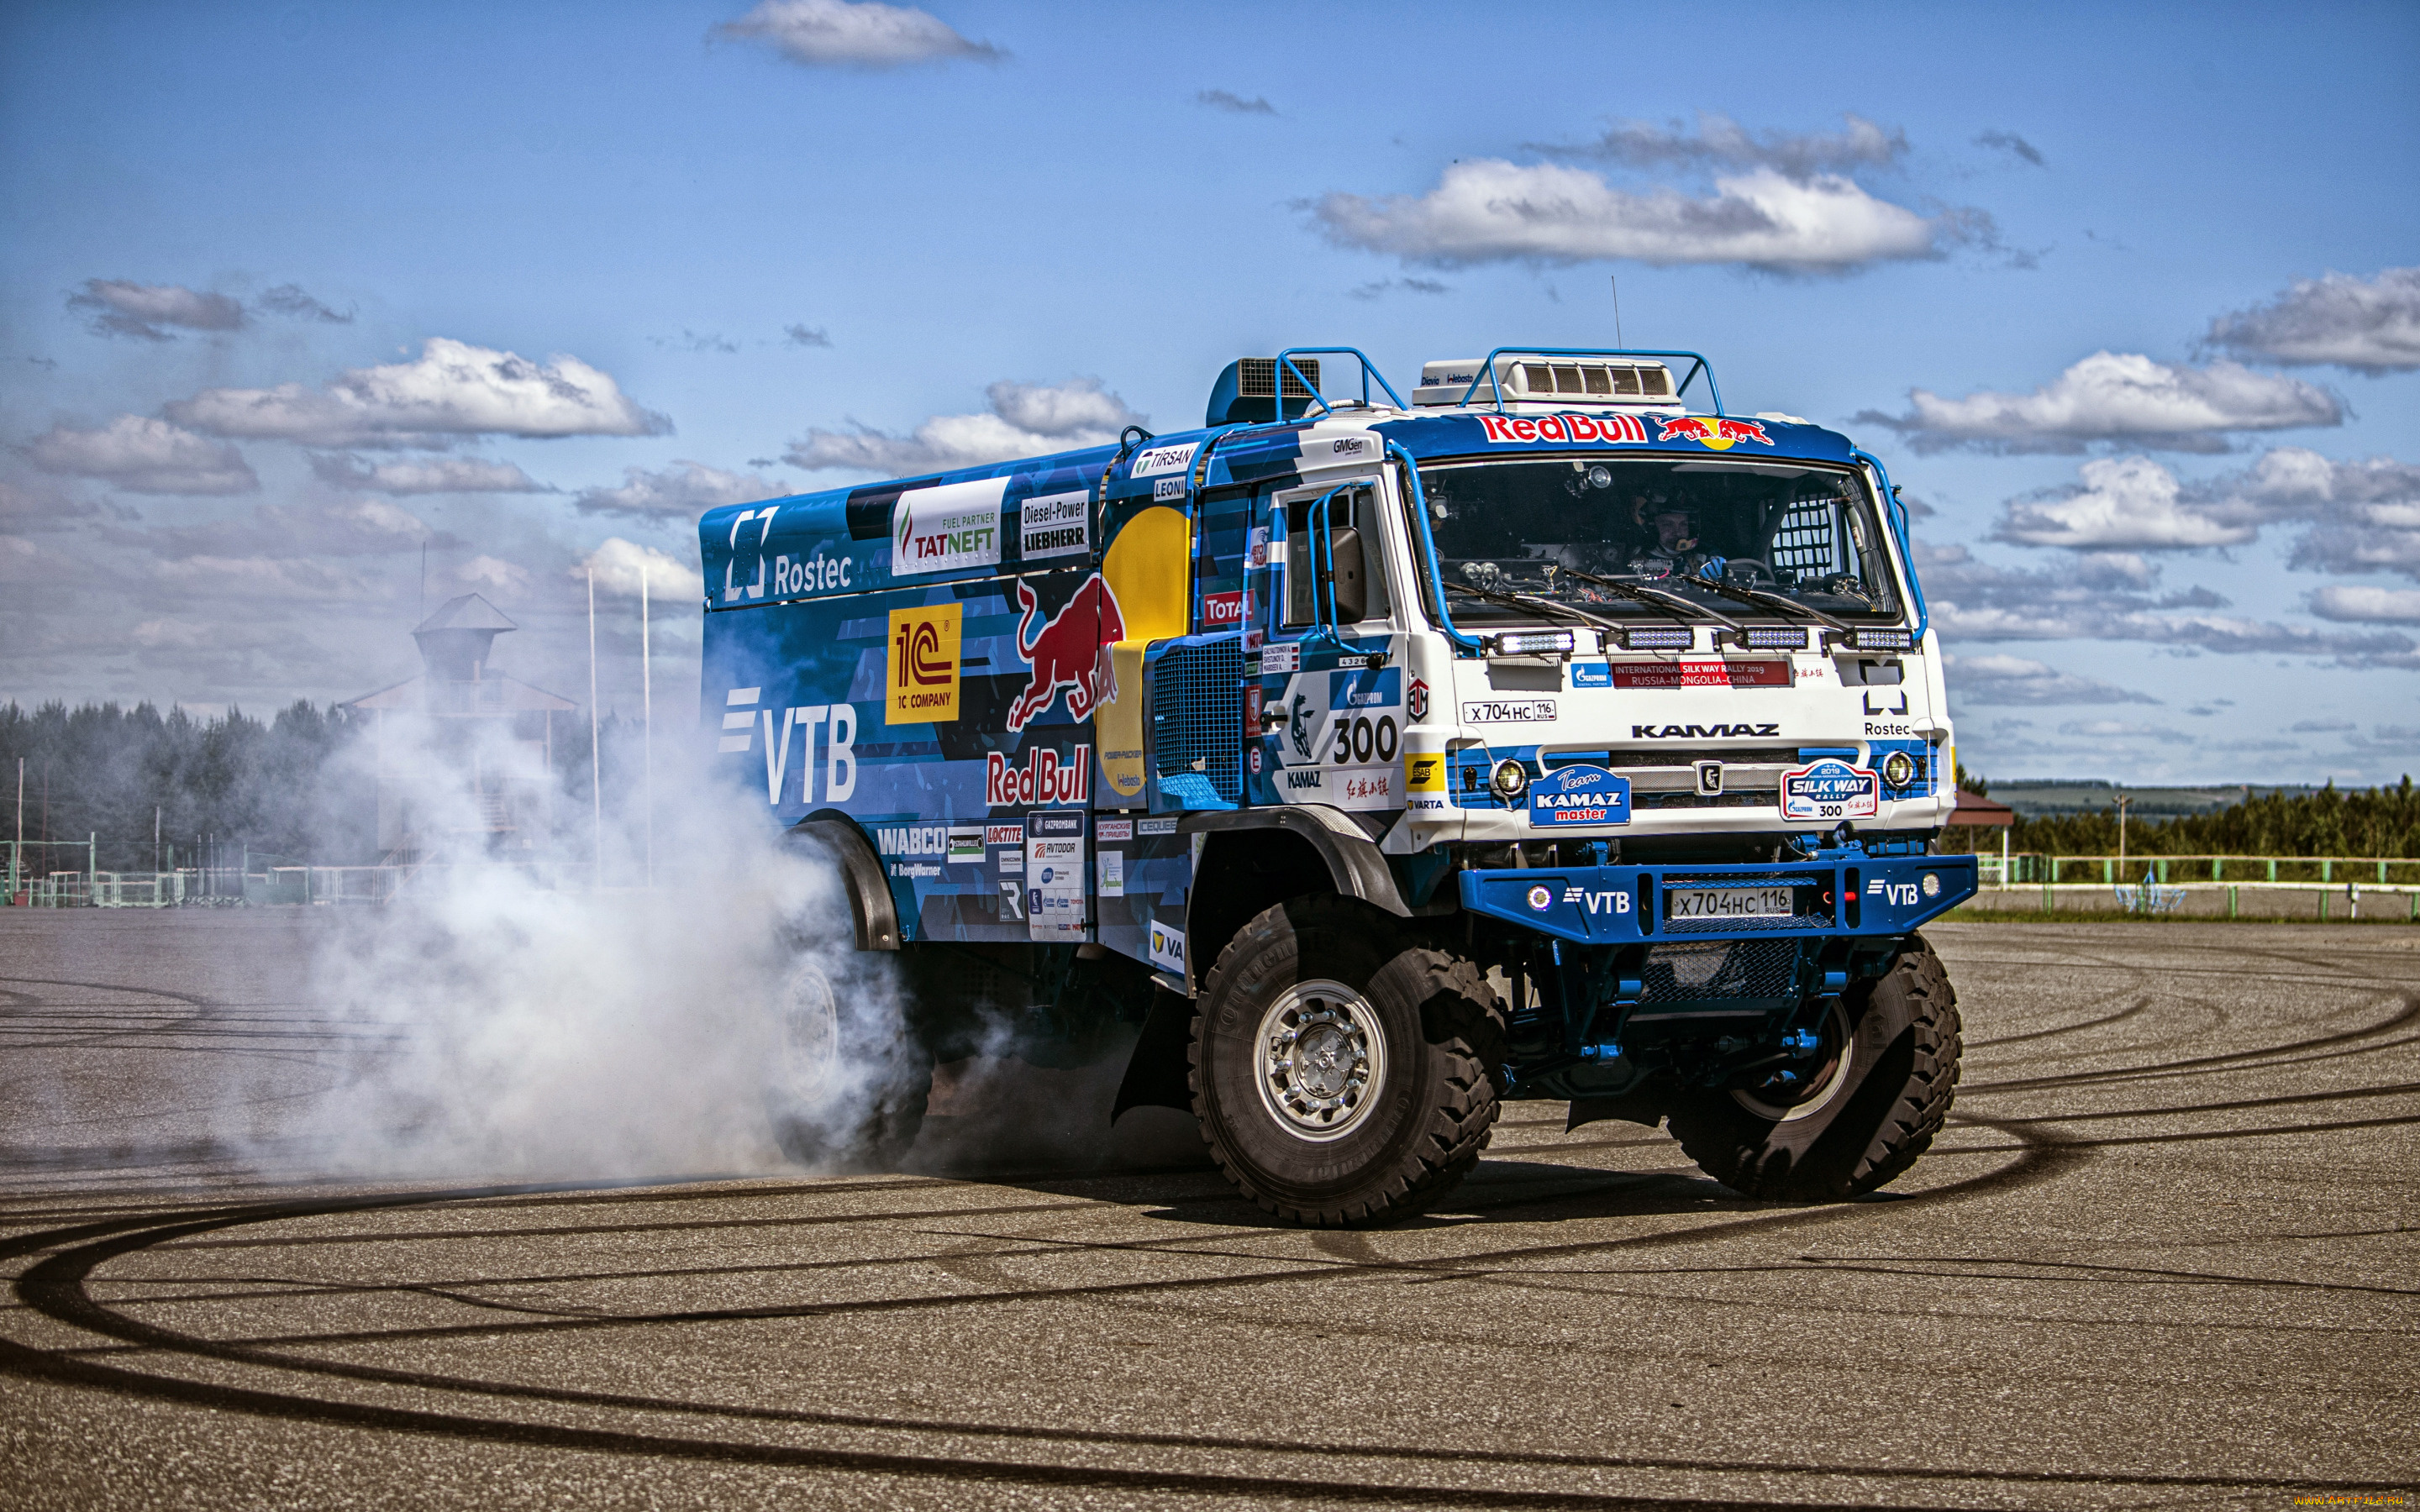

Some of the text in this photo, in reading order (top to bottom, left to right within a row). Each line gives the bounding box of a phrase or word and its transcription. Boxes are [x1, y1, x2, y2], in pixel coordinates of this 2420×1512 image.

[1422, 374, 1473, 386] Diavia Webasto
[1334, 438, 1362, 453] GMGen
[1155, 480, 1185, 497] LEONI
[1024, 501, 1085, 524] Diesel-Power
[943, 512, 995, 530] FUEL PARTNER
[915, 528, 994, 558] TATNEFT
[1024, 527, 1084, 552] LIEBHERR
[775, 553, 852, 595] Rostec
[1615, 664, 1765, 675] INTERNATIONAL SILK WAY RALLY 2019
[898, 691, 951, 710] 1C COMPANY
[1357, 692, 1382, 705] GAZPROM
[1536, 703, 1551, 713] 116
[1632, 723, 1780, 738] KAMAZ
[1865, 722, 1910, 735] Rostec
[1334, 715, 1397, 764] 300
[763, 704, 857, 805] VTB
[1118, 773, 1140, 786] Webasto
[1287, 770, 1321, 789] KAMAZ
[1413, 768, 1431, 776] ESAB
[1558, 769, 1601, 791] Team
[1346, 776, 1389, 800] 红旗小镇
[1791, 780, 1870, 793] SILK WAY
[1414, 800, 1444, 810] VARTA
[1537, 792, 1622, 808] KAMAZ
[1555, 808, 1607, 821] master
[1819, 806, 1842, 816] 300
[1044, 820, 1077, 830] GAZPROMBANK
[877, 827, 946, 855] WABCO
[987, 827, 1022, 843] LOCTITE
[1046, 843, 1075, 853] AVTODOR
[899, 863, 940, 879] BorgWarner
[1585, 891, 1630, 914] VTB
[1760, 890, 1786, 907] 116
[1886, 884, 1918, 906] VTB
